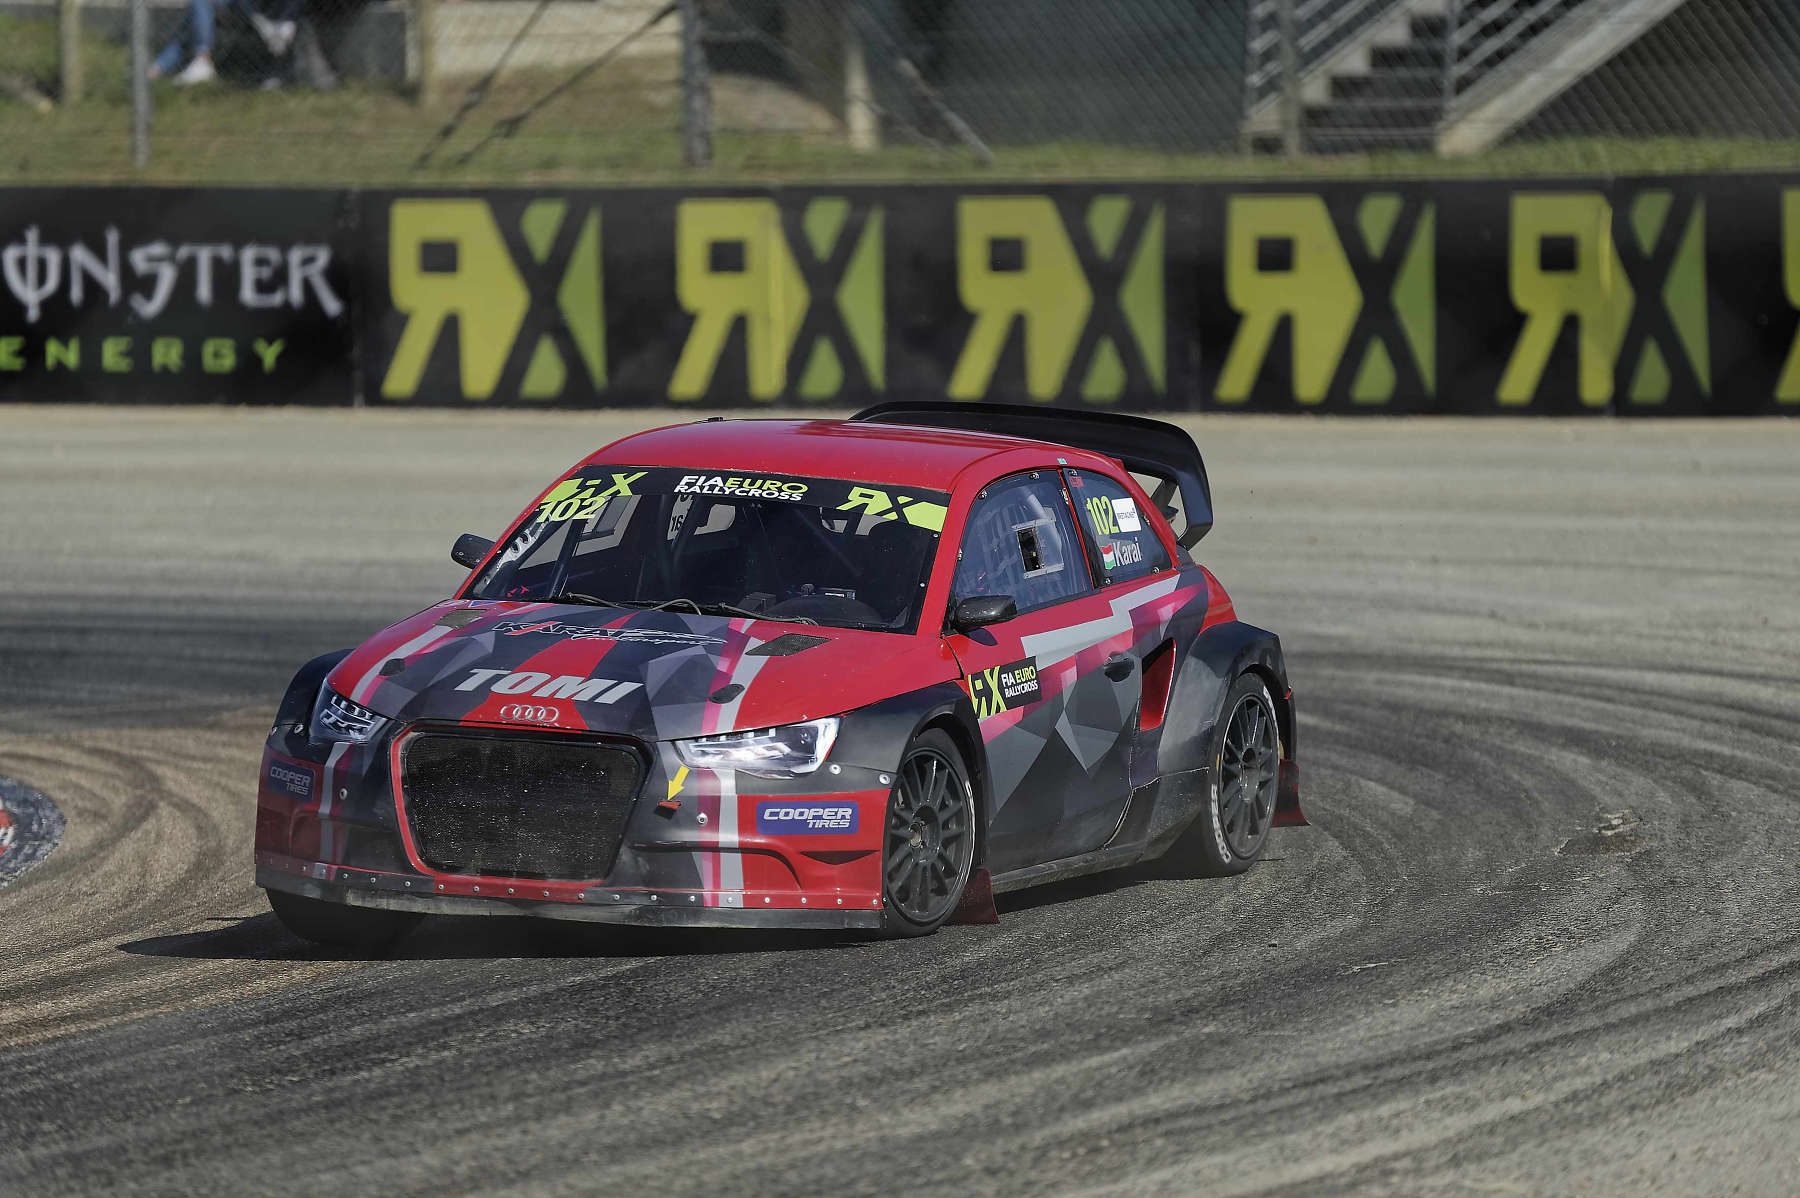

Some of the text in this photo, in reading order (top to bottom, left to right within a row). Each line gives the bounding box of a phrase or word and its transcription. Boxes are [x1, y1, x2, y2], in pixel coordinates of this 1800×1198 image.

[0, 336, 285, 372] ENERGY
[673, 485, 803, 501] RALLYCROSS
[536, 496, 607, 523] 102
[1086, 496, 1120, 535] 102
[1113, 536, 1142, 567] Karai
[454, 668, 645, 705] TOMI
[1001, 665, 1037, 688] FIA EURO
[1004, 679, 1039, 698] RALLYCROSS
[270, 766, 312, 787] COOPER
[285, 782, 309, 796] TIRES
[763, 807, 853, 820] COOPER
[806, 819, 851, 829] TIRES
